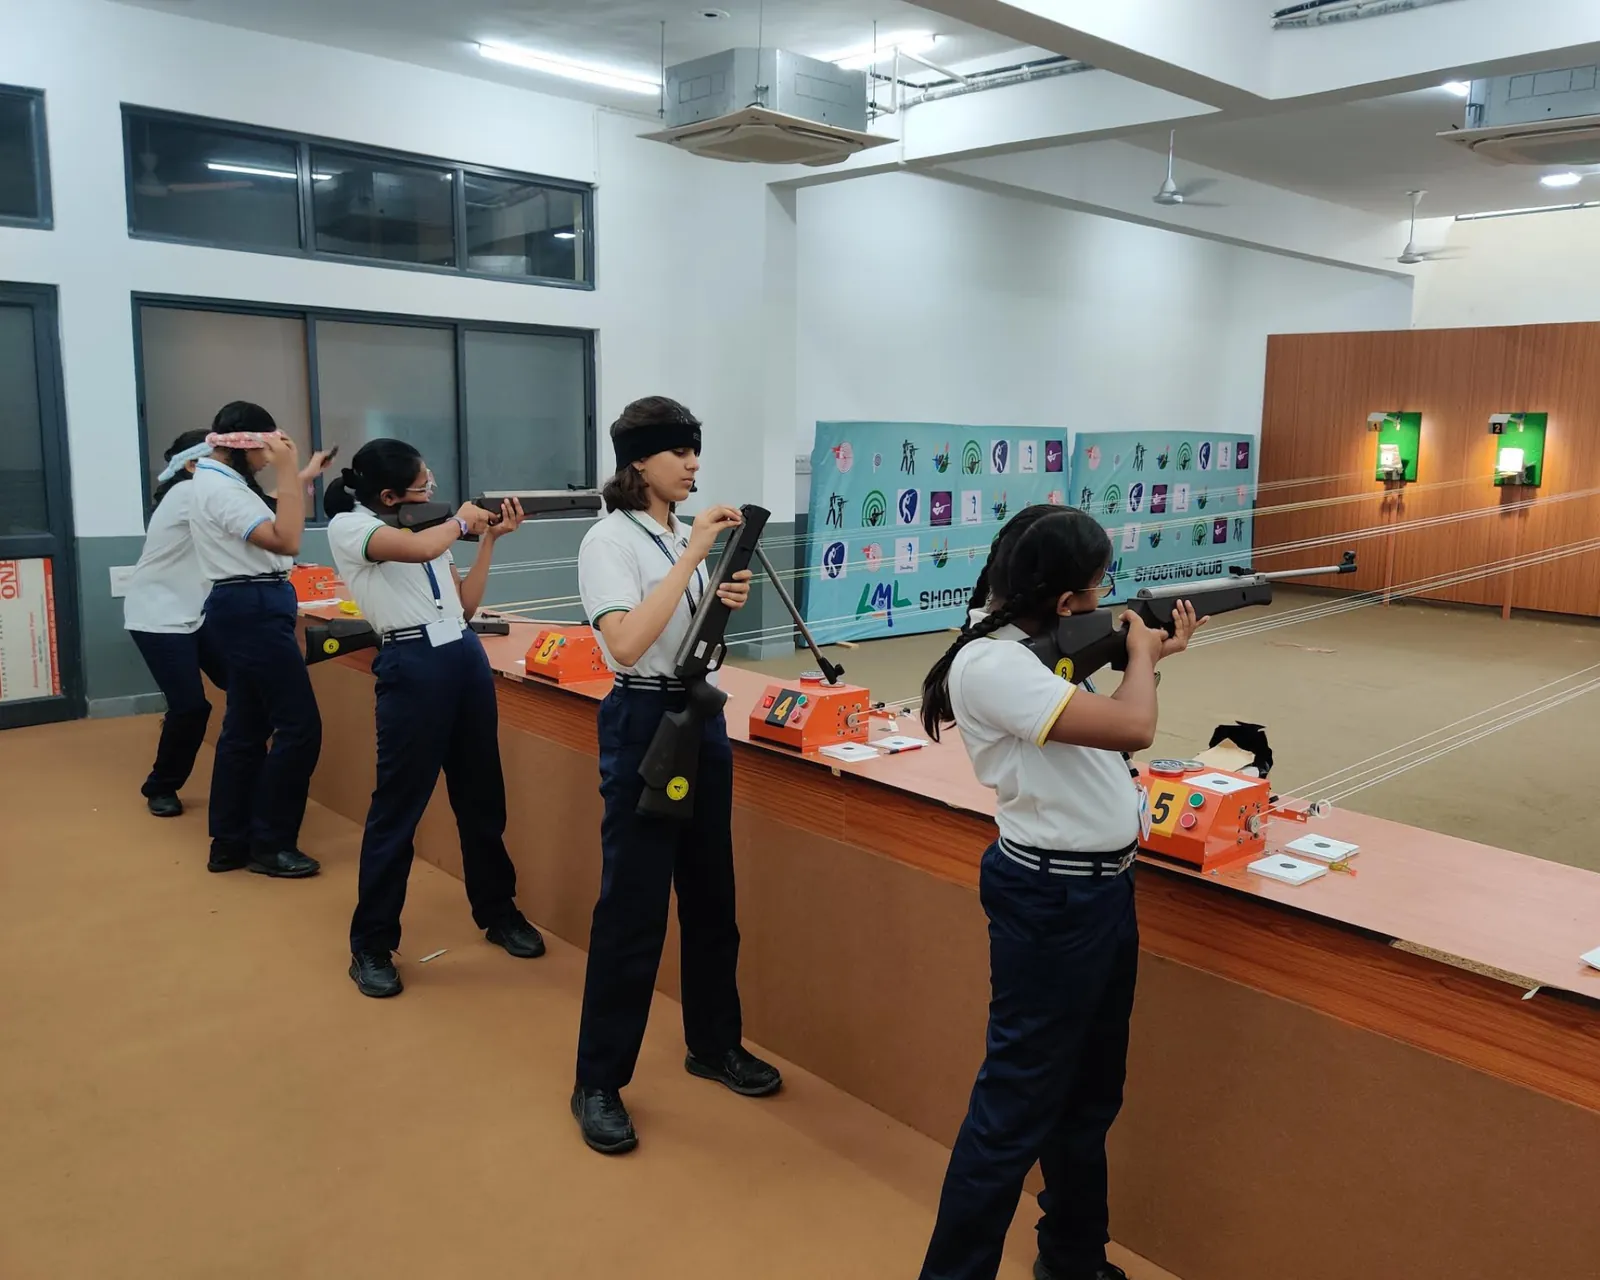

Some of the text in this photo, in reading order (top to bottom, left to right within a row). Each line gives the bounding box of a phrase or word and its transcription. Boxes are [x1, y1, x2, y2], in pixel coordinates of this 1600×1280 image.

[1493, 424, 1501, 432] 2
[1134, 563, 1194, 582] SHOOTING
[1195, 560, 1223, 577] CLUB
[919, 586, 975, 610] SHOOT
[542, 639, 556, 657] 3
[774, 696, 793, 720] 4
[1151, 792, 1175, 824] 5
